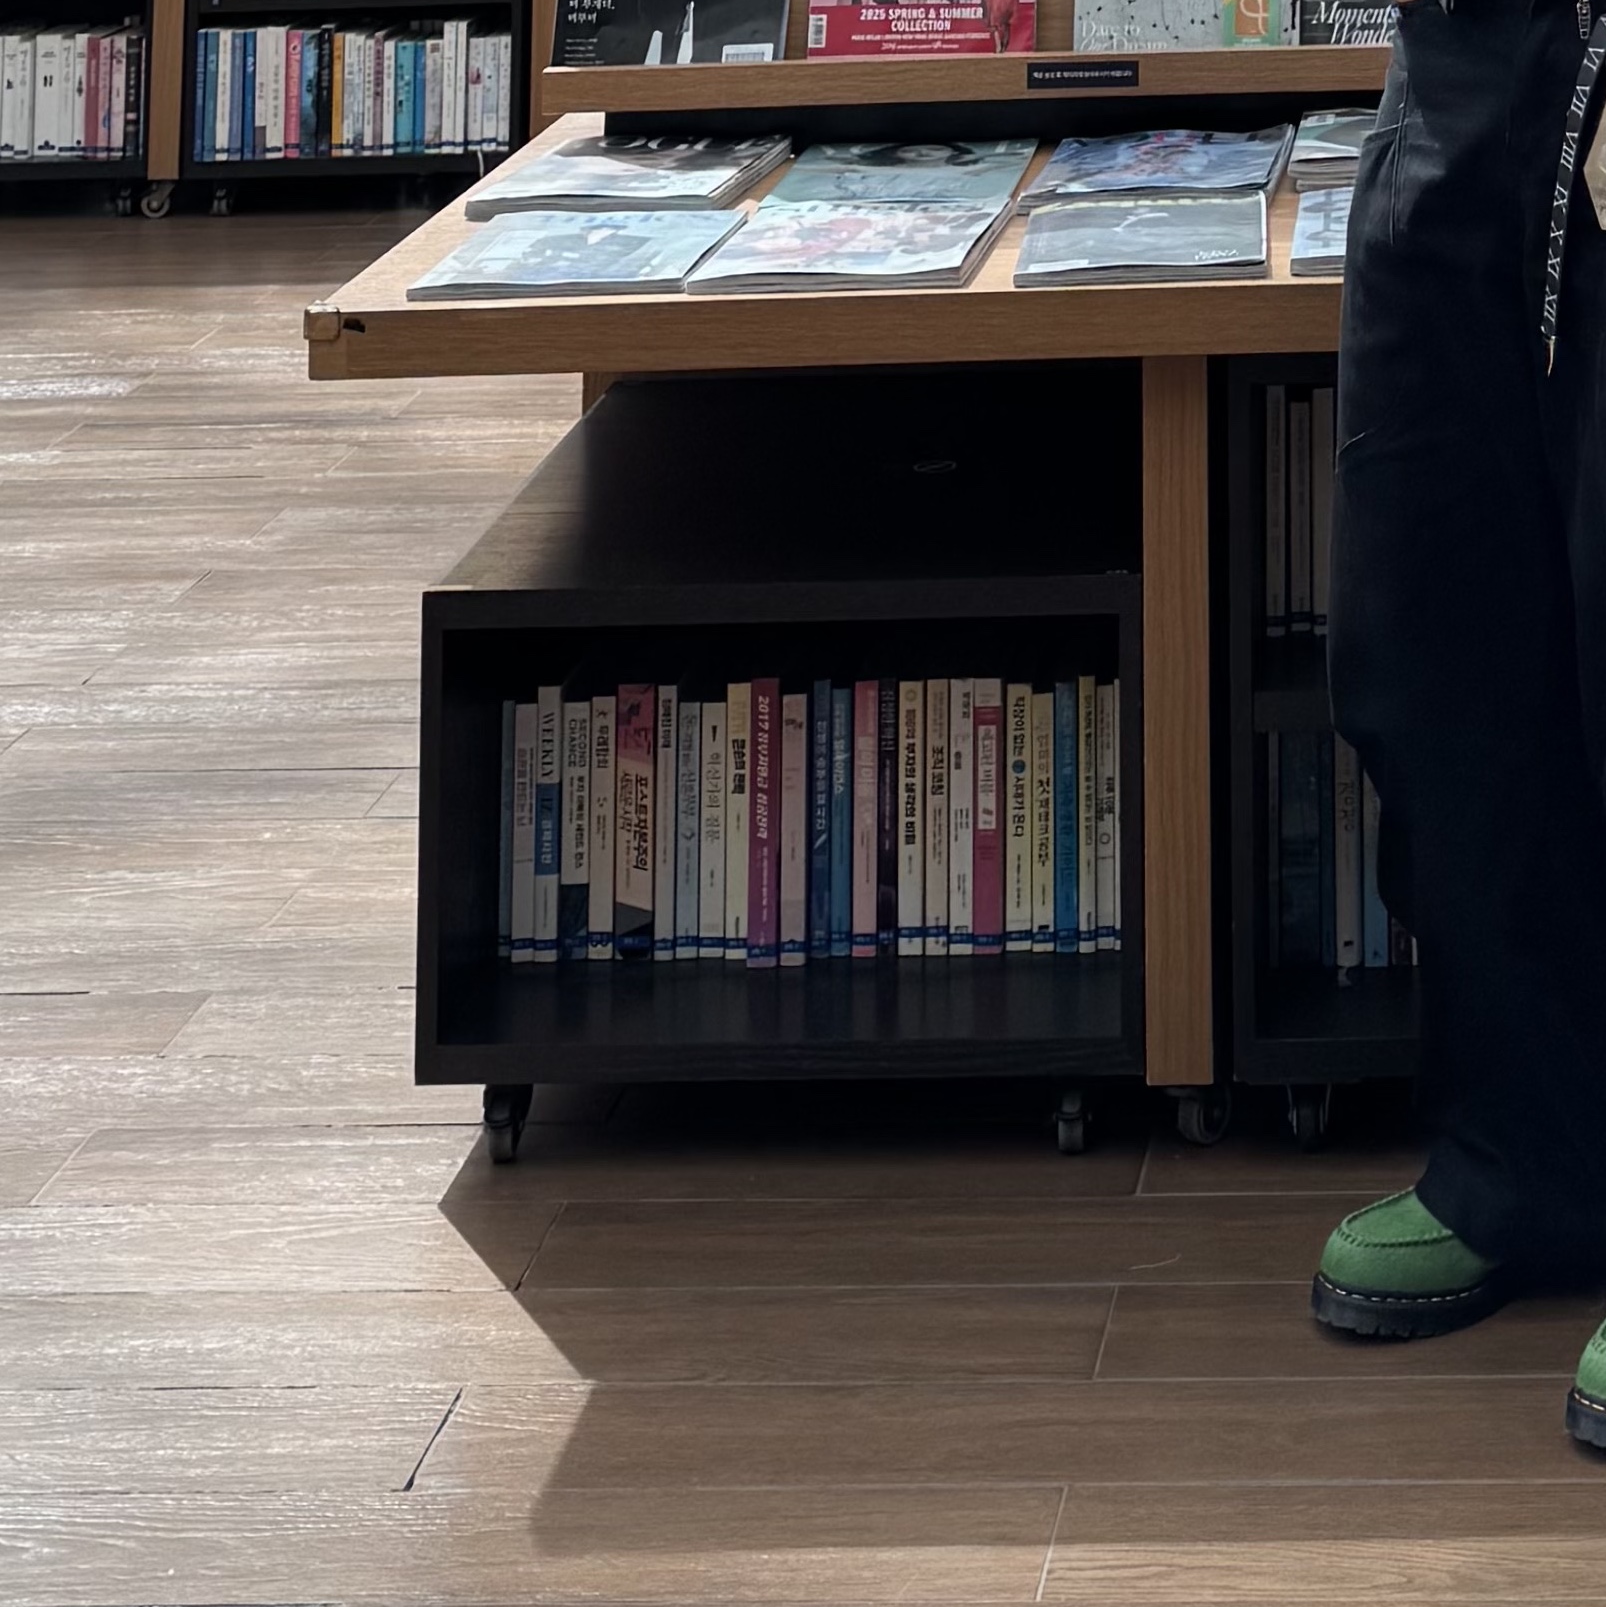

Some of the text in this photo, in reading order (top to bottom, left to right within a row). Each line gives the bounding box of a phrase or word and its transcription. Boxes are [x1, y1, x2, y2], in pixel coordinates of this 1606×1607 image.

[888, 8, 926, 20] SPRING
[939, 7, 984, 19] SUMMER
[891, 19, 952, 32] COLLECTION
[758, 695, 769, 730] 2017
[541, 712, 555, 778] WEEKLY
[568, 718, 578, 768] CHANCE
[577, 718, 587, 768] SECOND
[632, 774, 649, 871] 포스트자본주의
